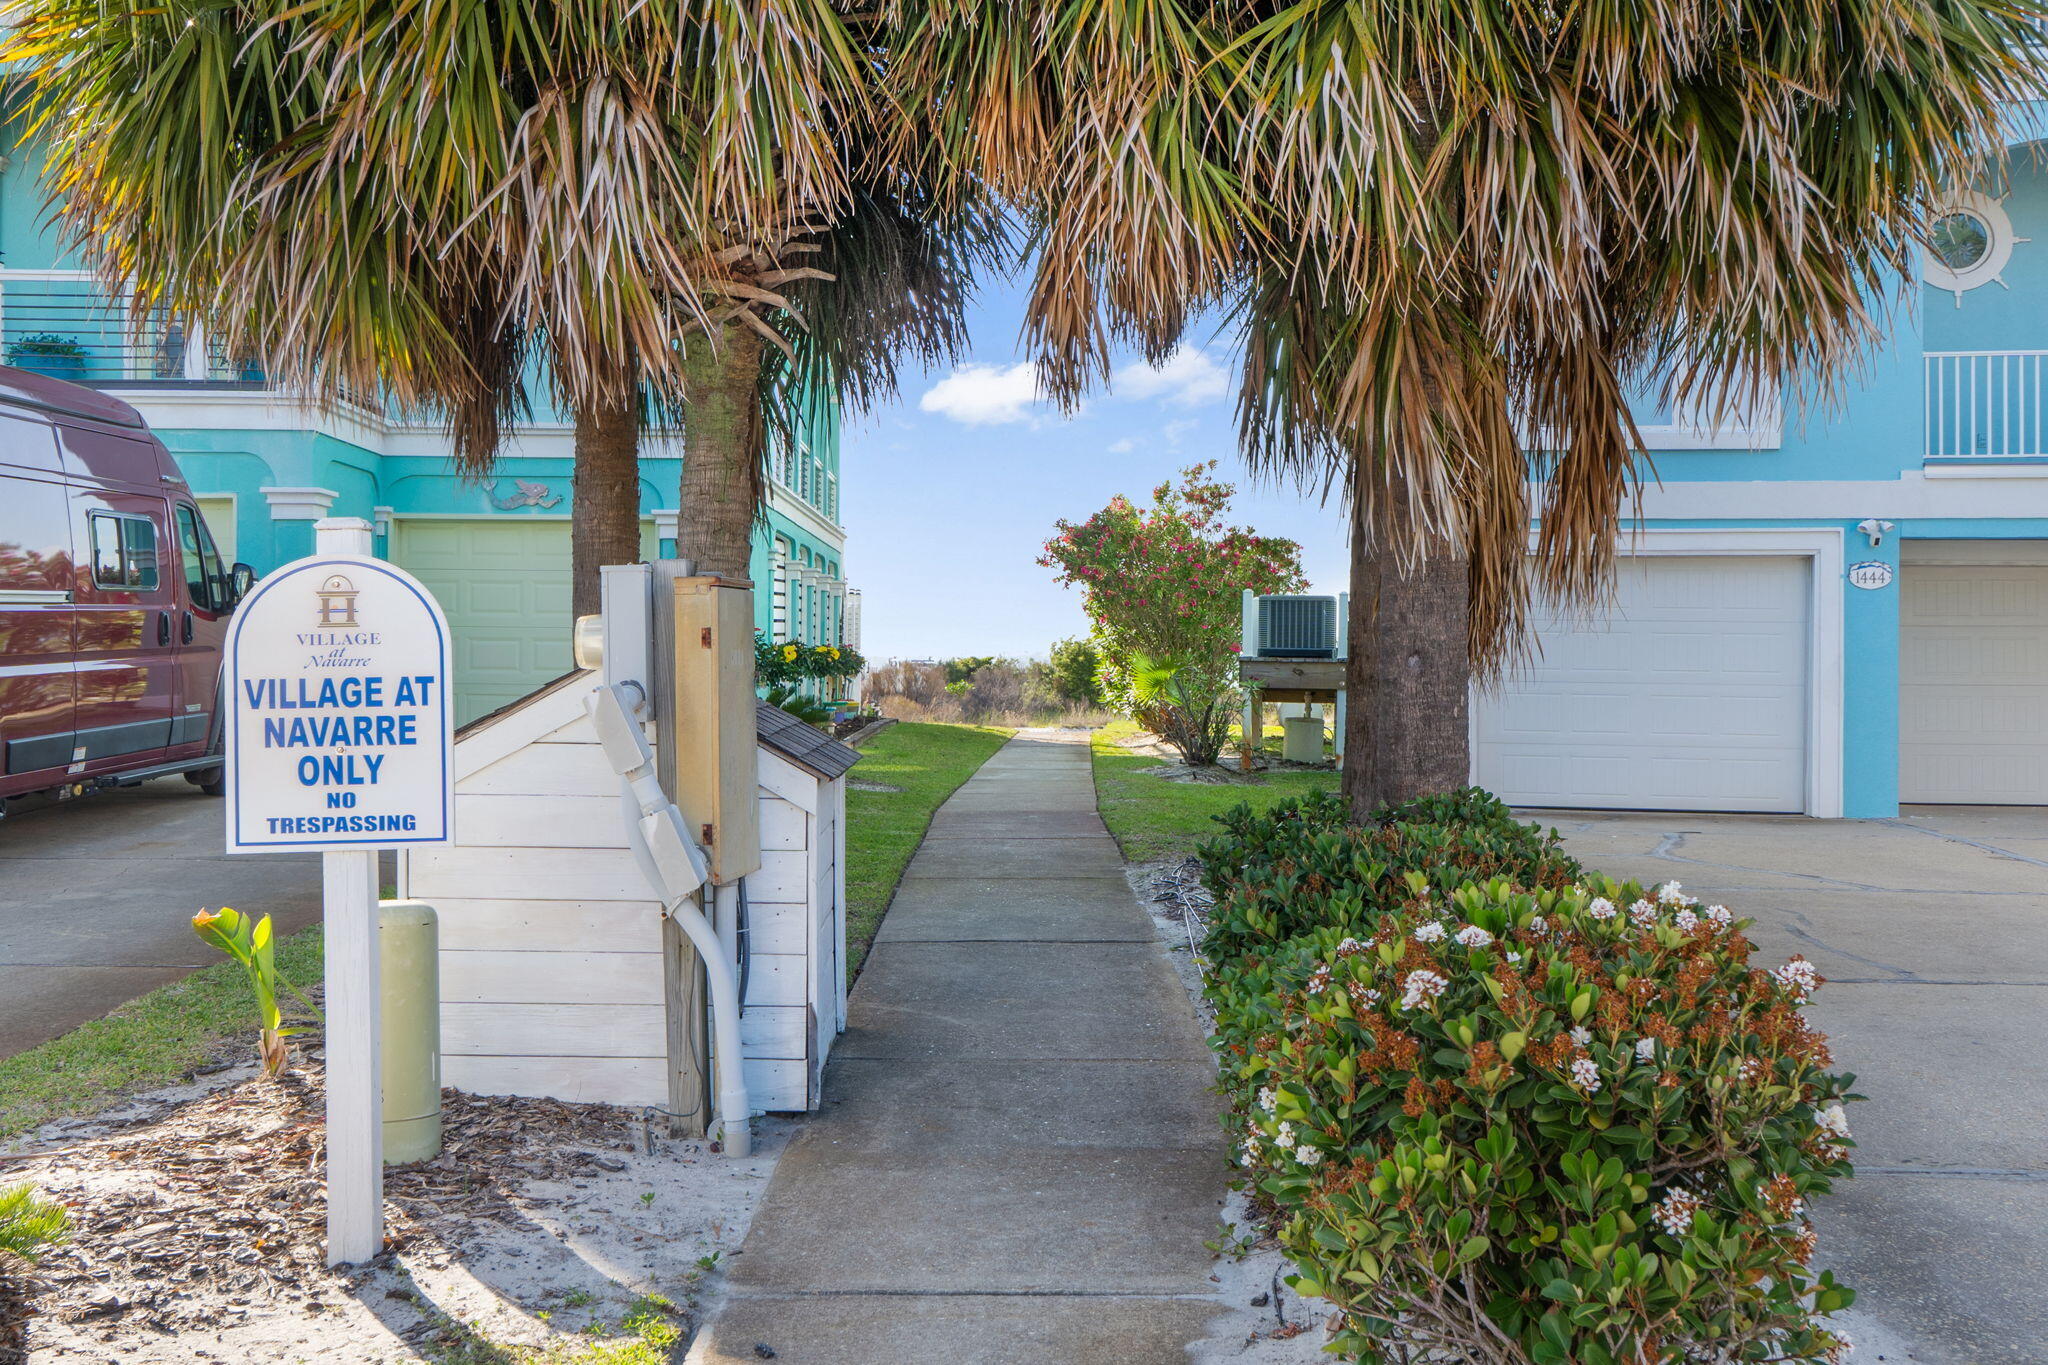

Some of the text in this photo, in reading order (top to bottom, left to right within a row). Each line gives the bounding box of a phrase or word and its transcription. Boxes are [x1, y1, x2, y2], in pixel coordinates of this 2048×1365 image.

[1856, 571, 1885, 583] 1444
[297, 632, 382, 646] VILLAGE
[329, 647, 346, 659] at
[304, 655, 372, 669] Navarre
[244, 676, 435, 709] VILLAGE AT
[264, 714, 417, 748] NAVARRE
[297, 754, 385, 786] ONLY
[327, 792, 356, 809] NO
[266, 815, 416, 834] TRESPASSING
